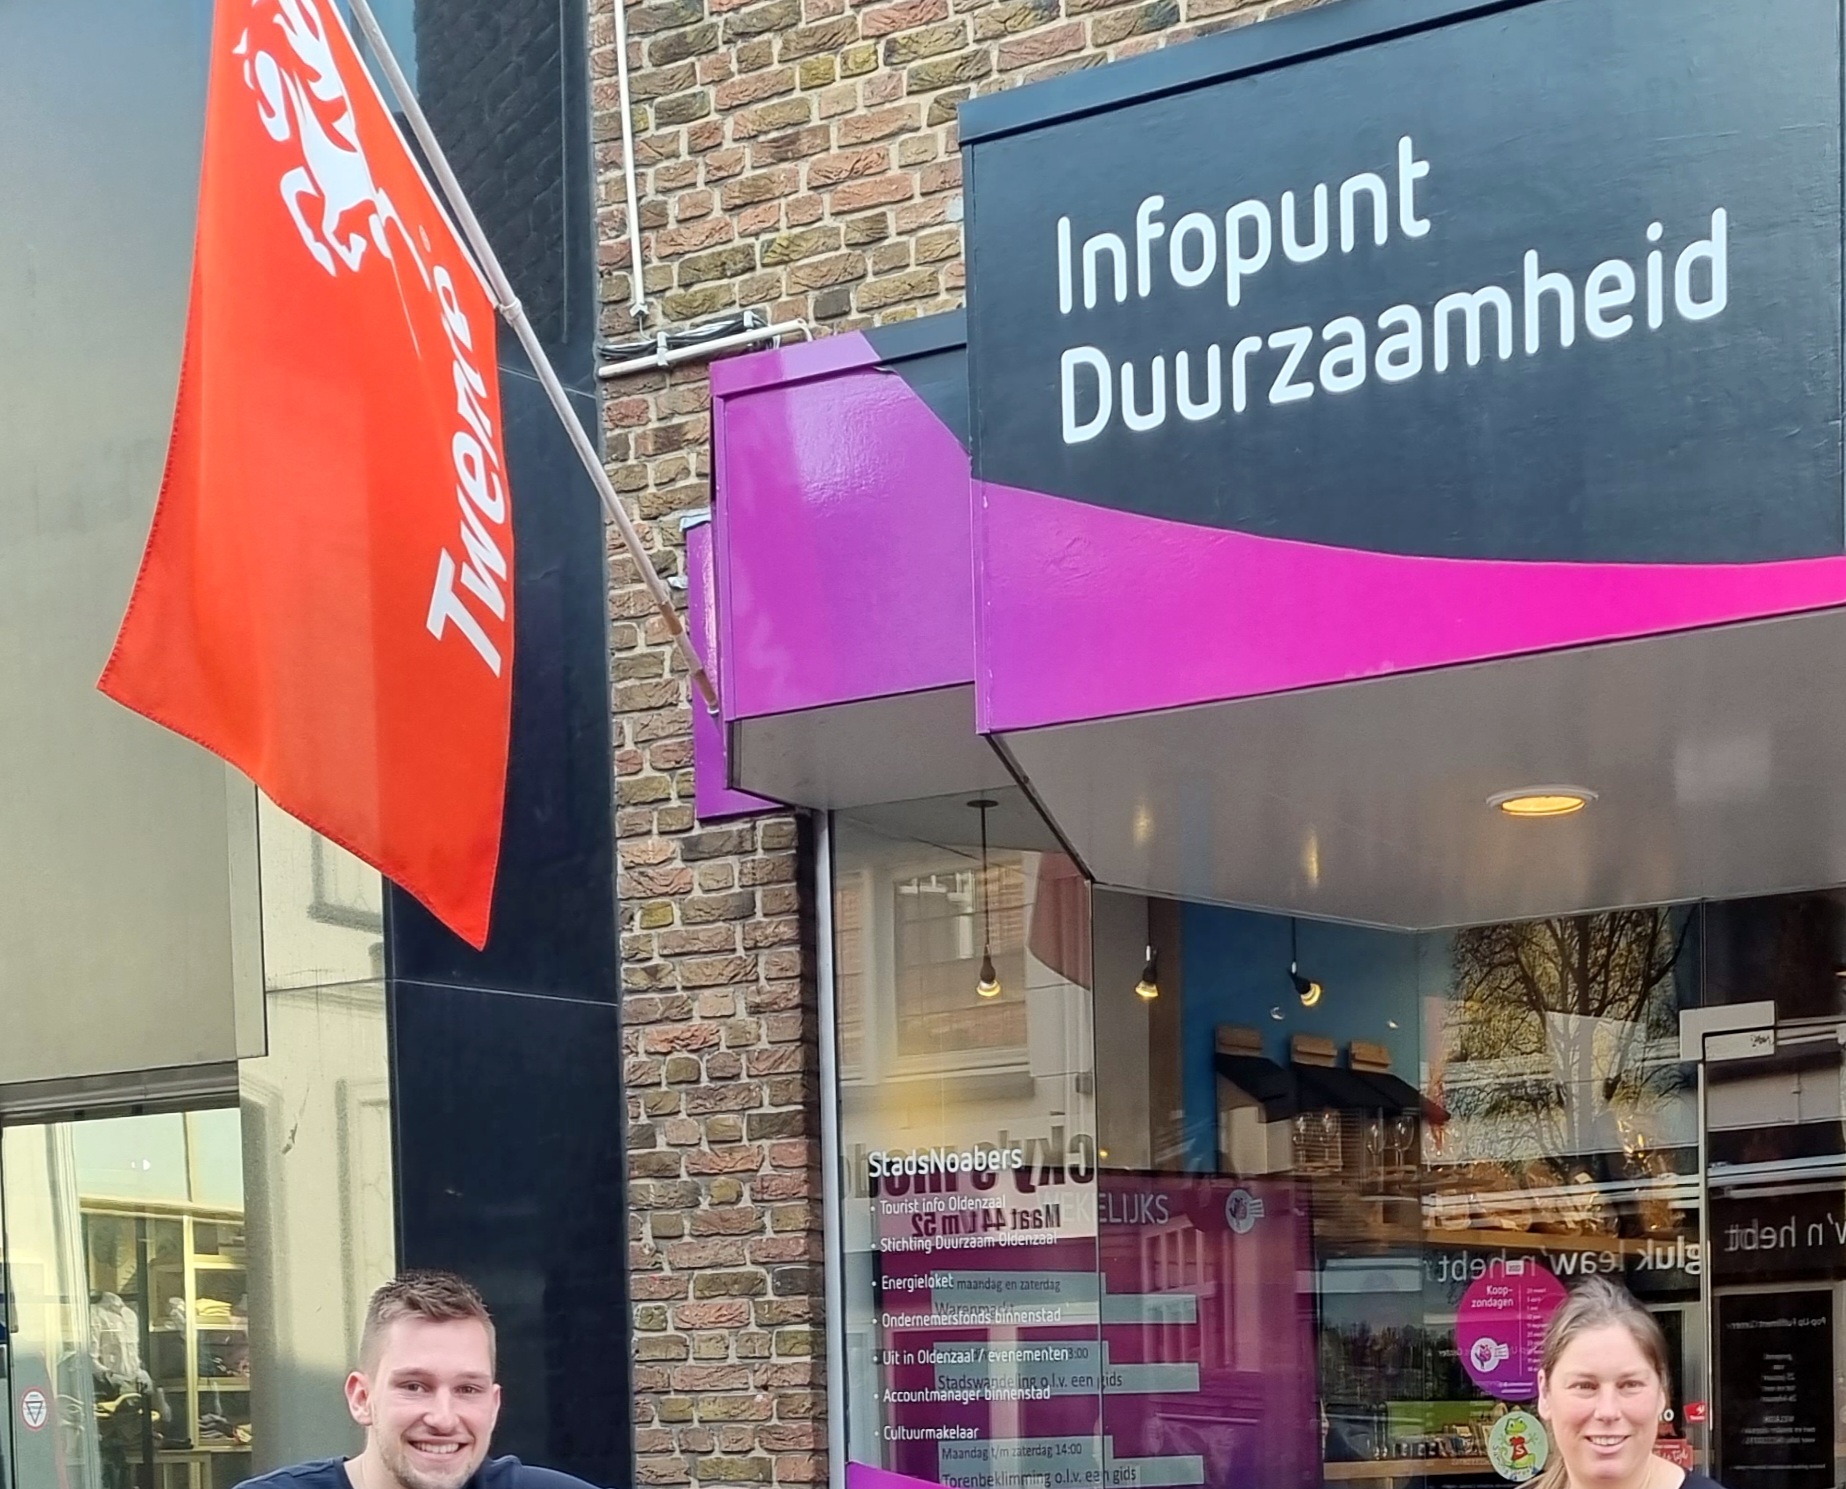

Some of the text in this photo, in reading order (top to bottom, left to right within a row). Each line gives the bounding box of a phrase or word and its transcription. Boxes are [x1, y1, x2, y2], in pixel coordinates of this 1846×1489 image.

[1056, 135, 1430, 314] Infopunt
[1061, 207, 1728, 444] Duurzaamheid
[868, 1146, 1022, 1177] StadsNoabers
[880, 1194, 1006, 1215] Tourist info Oldenzaal
[881, 1231, 1058, 1254] Stichting Duurzaam Oldenzaal
[882, 1273, 953, 1293] Energieloket
[956, 1277, 1061, 1293] maandag en zaterdag
[1471, 1297, 1514, 1309] zondagen
[882, 1307, 1062, 1328] Ondernemersfonds binnenstad
[883, 1351, 900, 1366] Uit
[904, 1350, 914, 1364] in
[917, 1348, 974, 1365] Oldenzaal
[988, 1346, 1069, 1363] evenementen
[1071, 1376, 1093, 1388] een
[883, 1385, 1051, 1404] Accountmanager binnenstad
[884, 1424, 980, 1441] Cultuurmakelaar
[941, 1446, 988, 1461] Maandag
[1055, 1443, 1083, 1456] 14:00
[1112, 1466, 1137, 1485] gids
